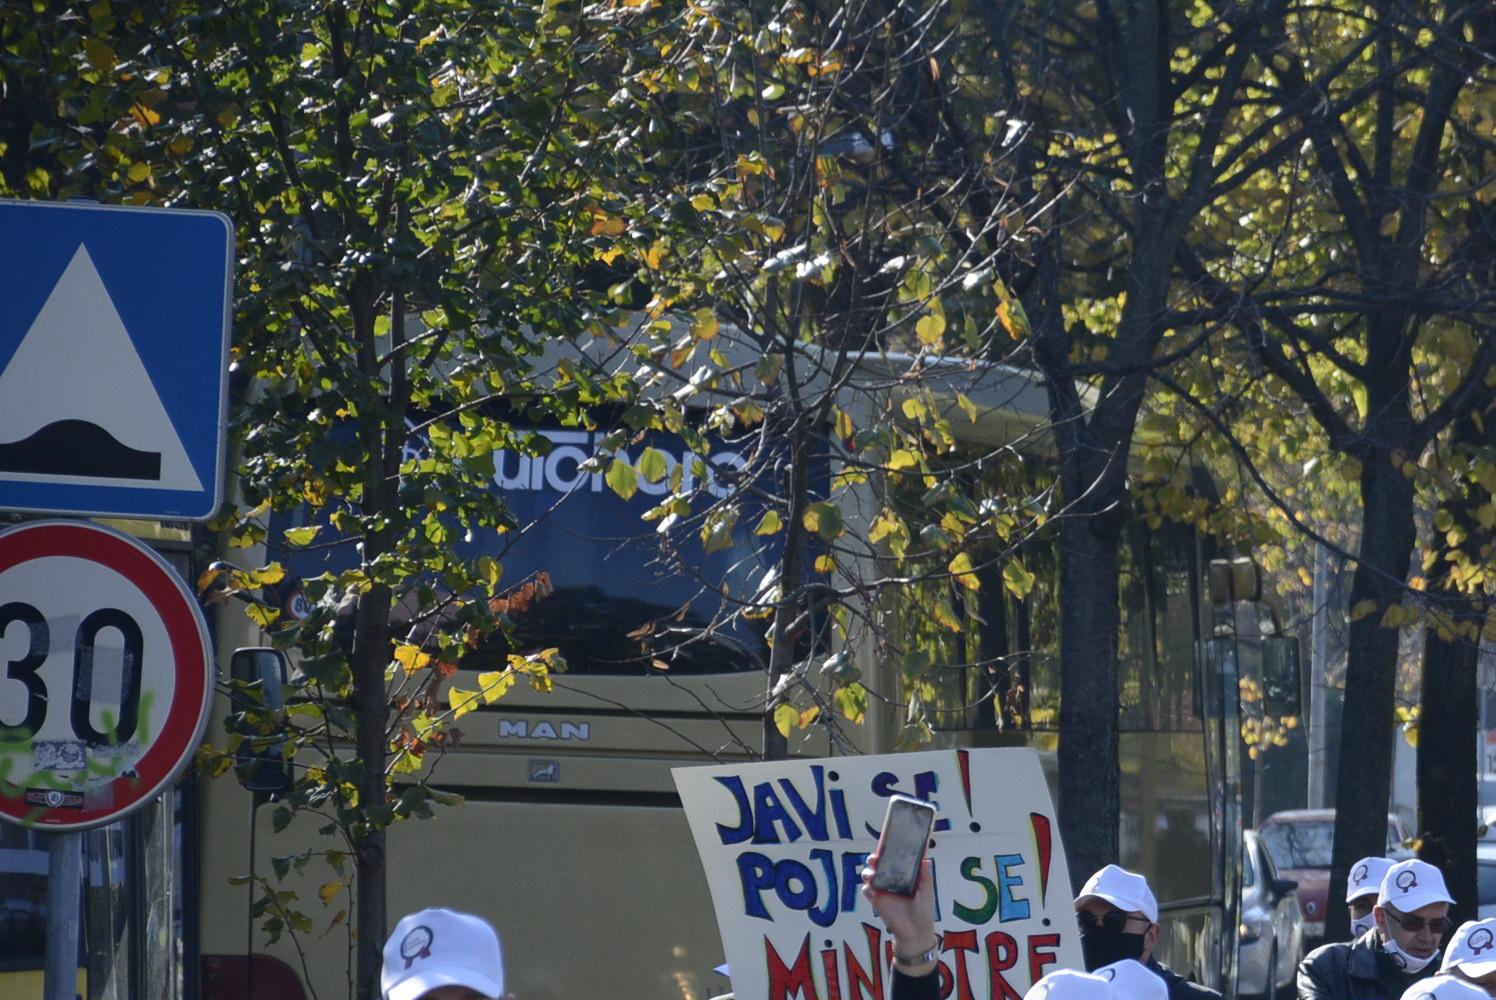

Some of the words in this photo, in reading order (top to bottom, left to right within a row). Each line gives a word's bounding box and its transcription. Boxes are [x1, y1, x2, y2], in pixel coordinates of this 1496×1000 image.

[0, 601, 144, 750] 30
[499, 719, 591, 741] MAN
[952, 811, 1053, 927] SE!
